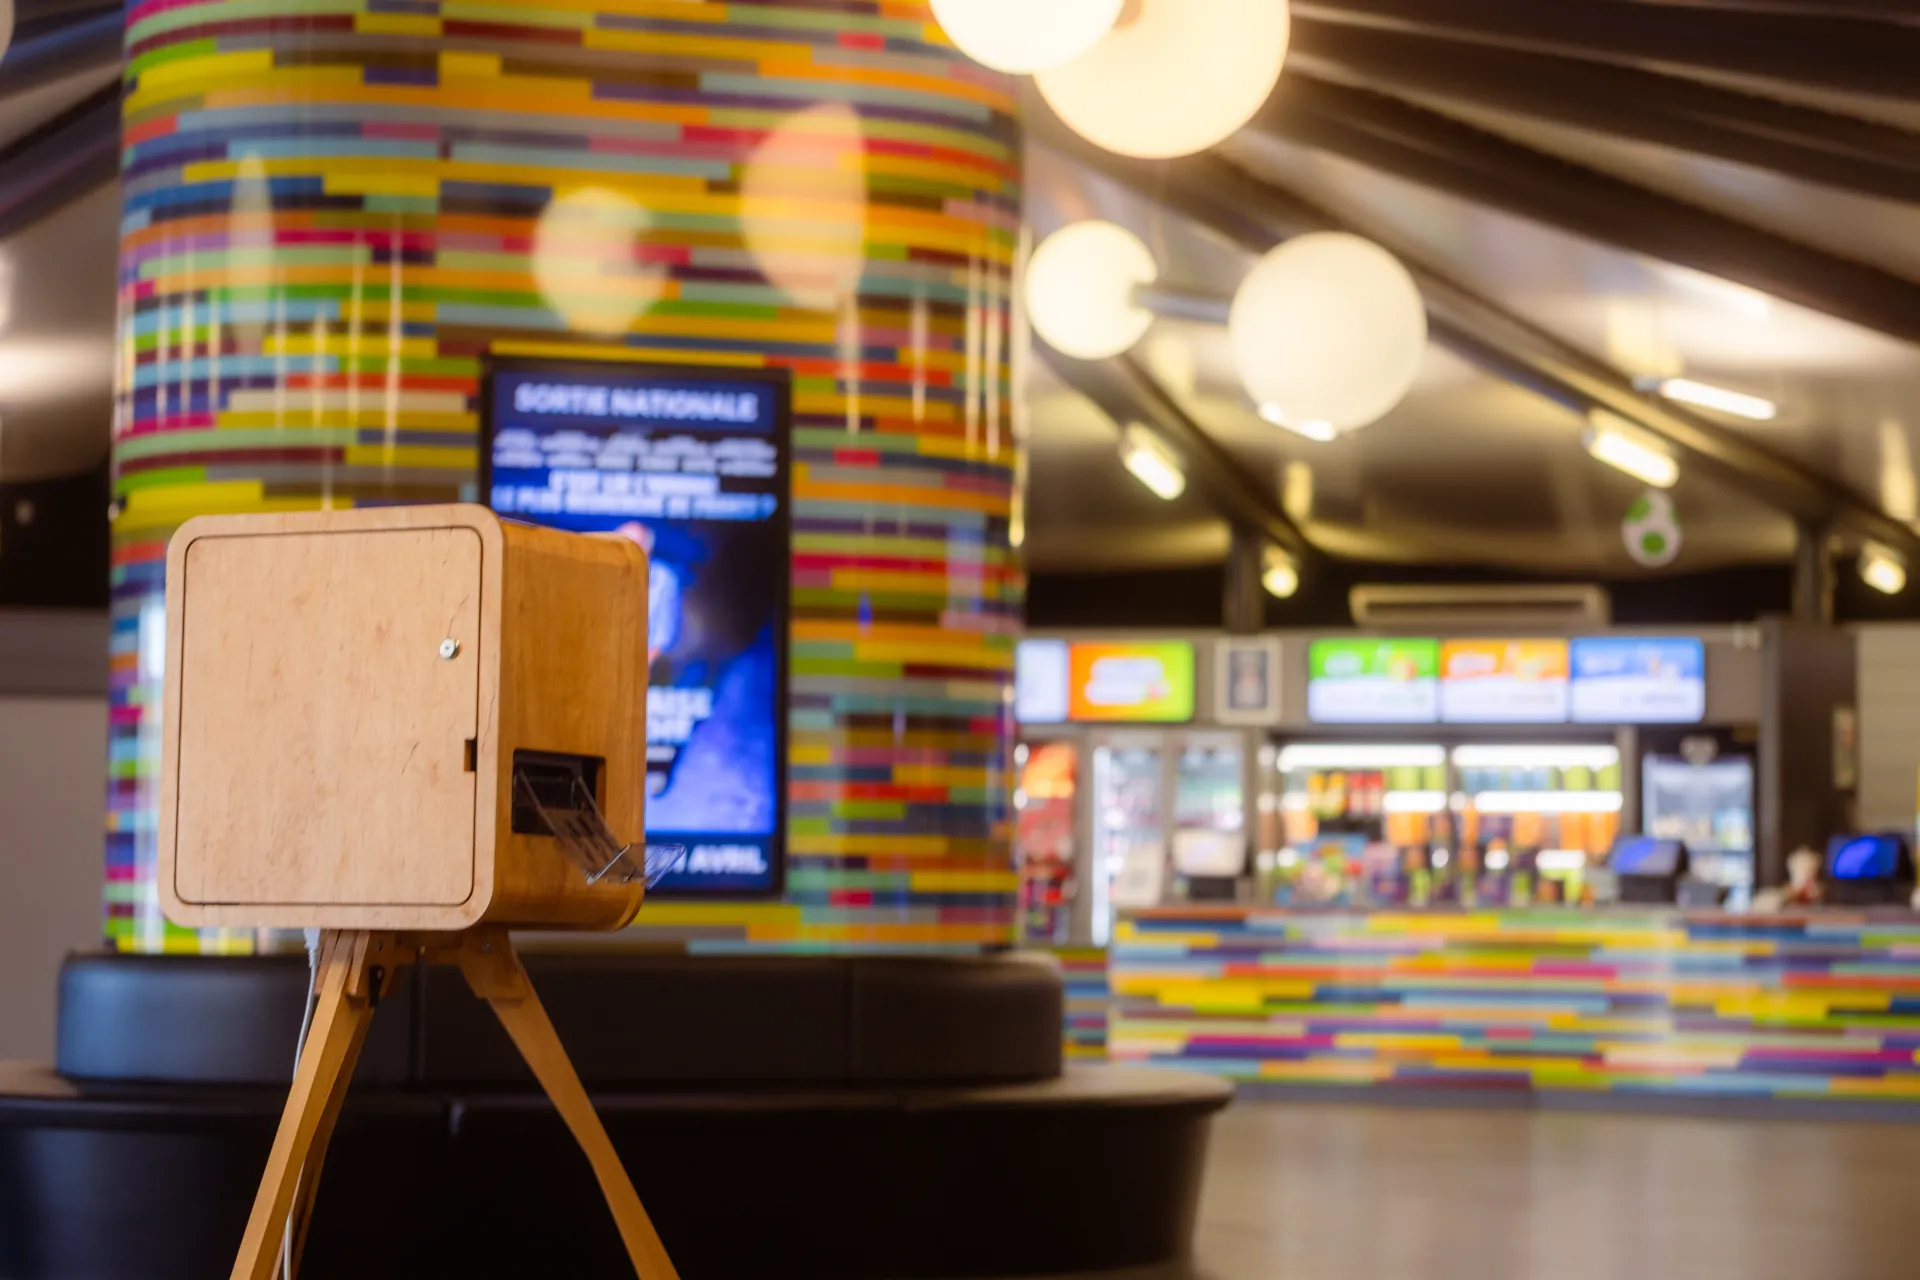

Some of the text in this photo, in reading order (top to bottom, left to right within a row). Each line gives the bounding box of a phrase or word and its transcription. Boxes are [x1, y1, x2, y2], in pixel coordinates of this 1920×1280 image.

[515, 384, 757, 421] SORTIE NATIONALE
[688, 845, 767, 873] AVRIL
